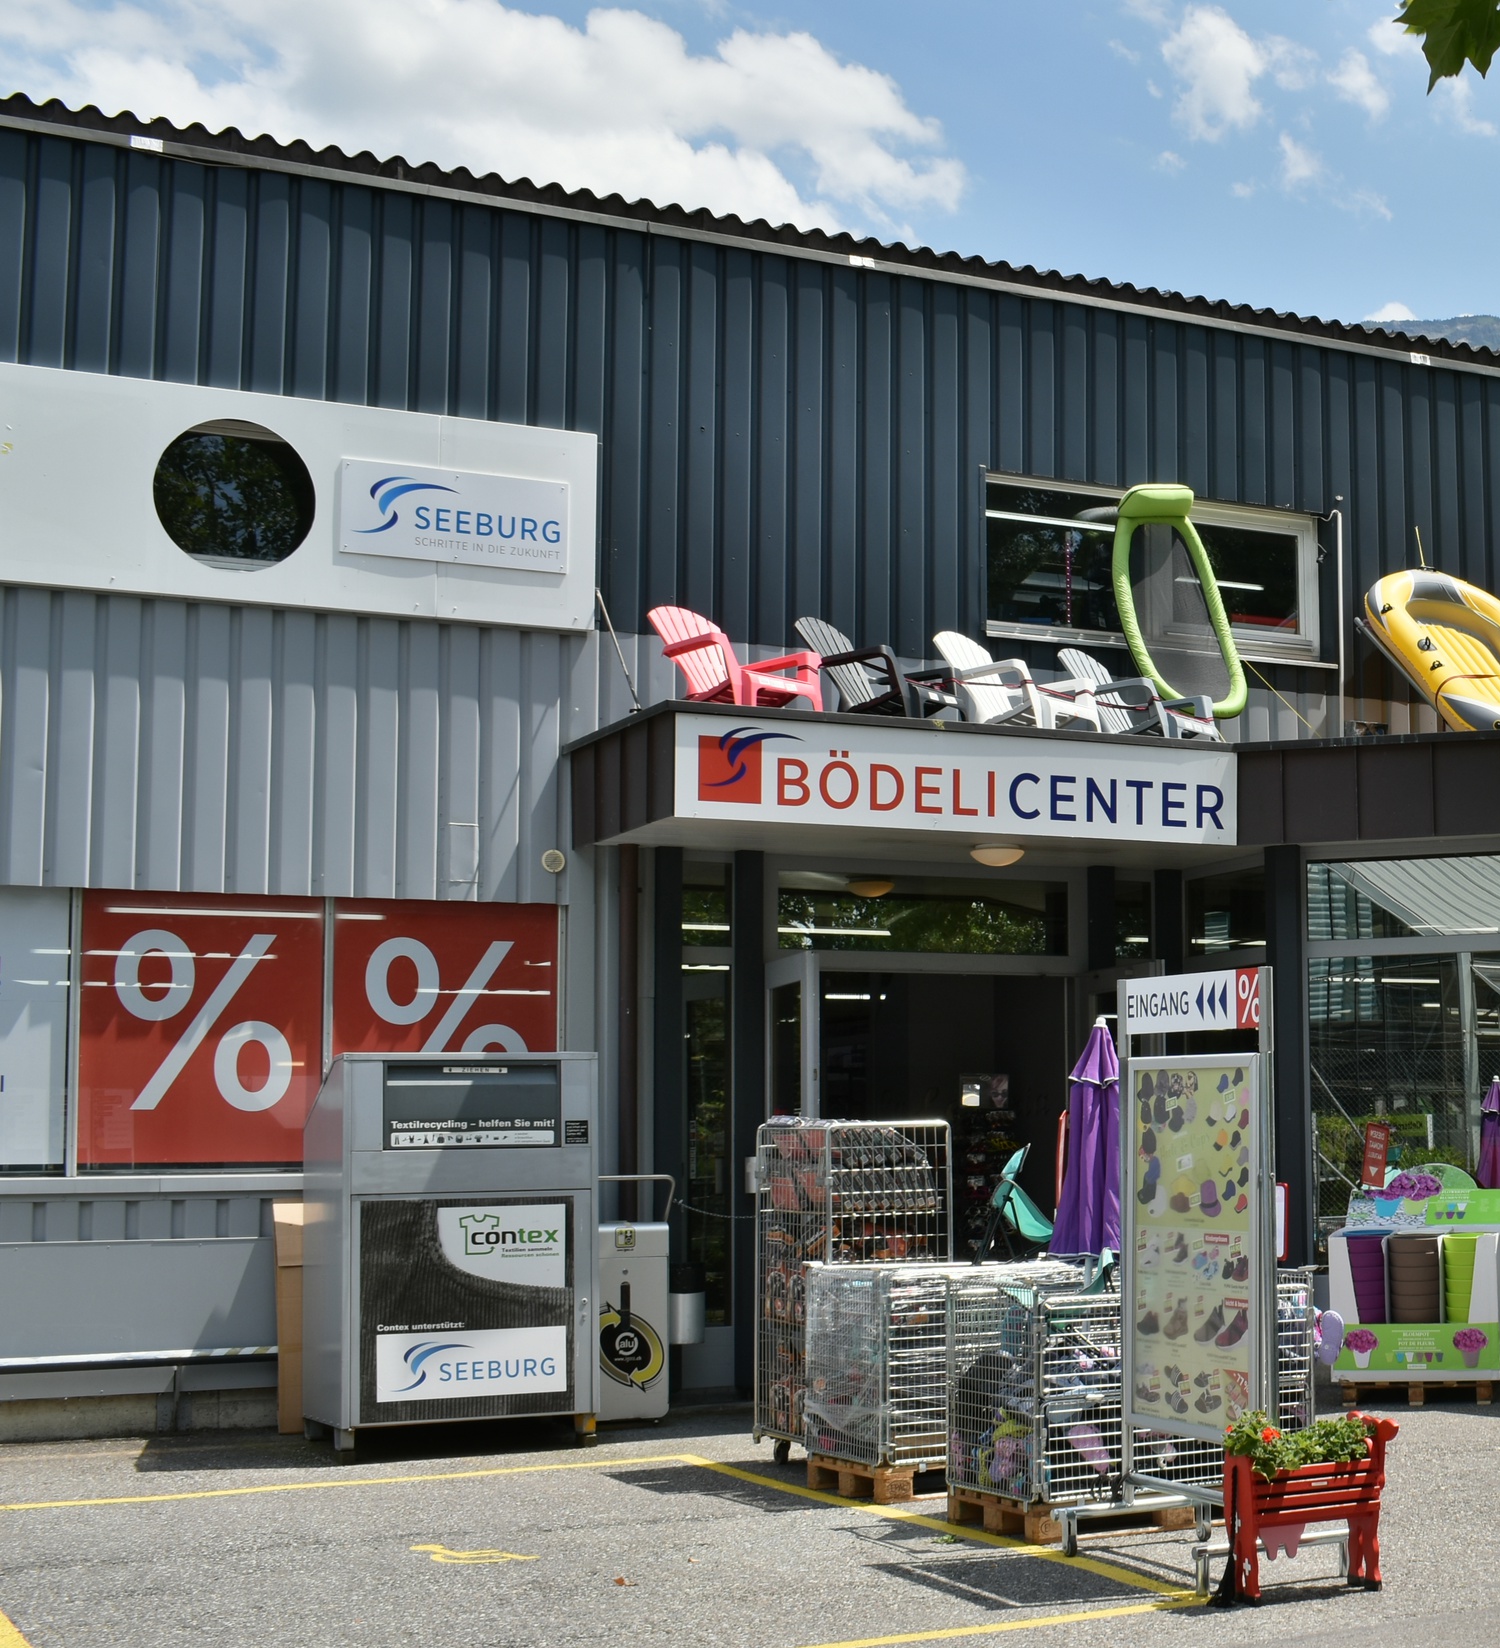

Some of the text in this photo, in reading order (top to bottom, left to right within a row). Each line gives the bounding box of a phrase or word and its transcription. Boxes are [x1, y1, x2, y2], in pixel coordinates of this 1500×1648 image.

[414, 506, 561, 544] SEEBURG
[415, 536, 560, 560] SCHRITTE IN DIE ZUKUNFT
[1127, 990, 1190, 1019] EINGANG
[114, 929, 293, 1112] %
[391, 1120, 468, 1130] Textilrecycling
[479, 1119, 511, 1128] helfen
[514, 1119, 531, 1128] Sie
[533, 1119, 555, 1128] mit!
[471, 1228, 559, 1246] contex
[377, 1321, 465, 1332] Contex unterstützt:
[439, 1357, 556, 1382] SEEBURG
